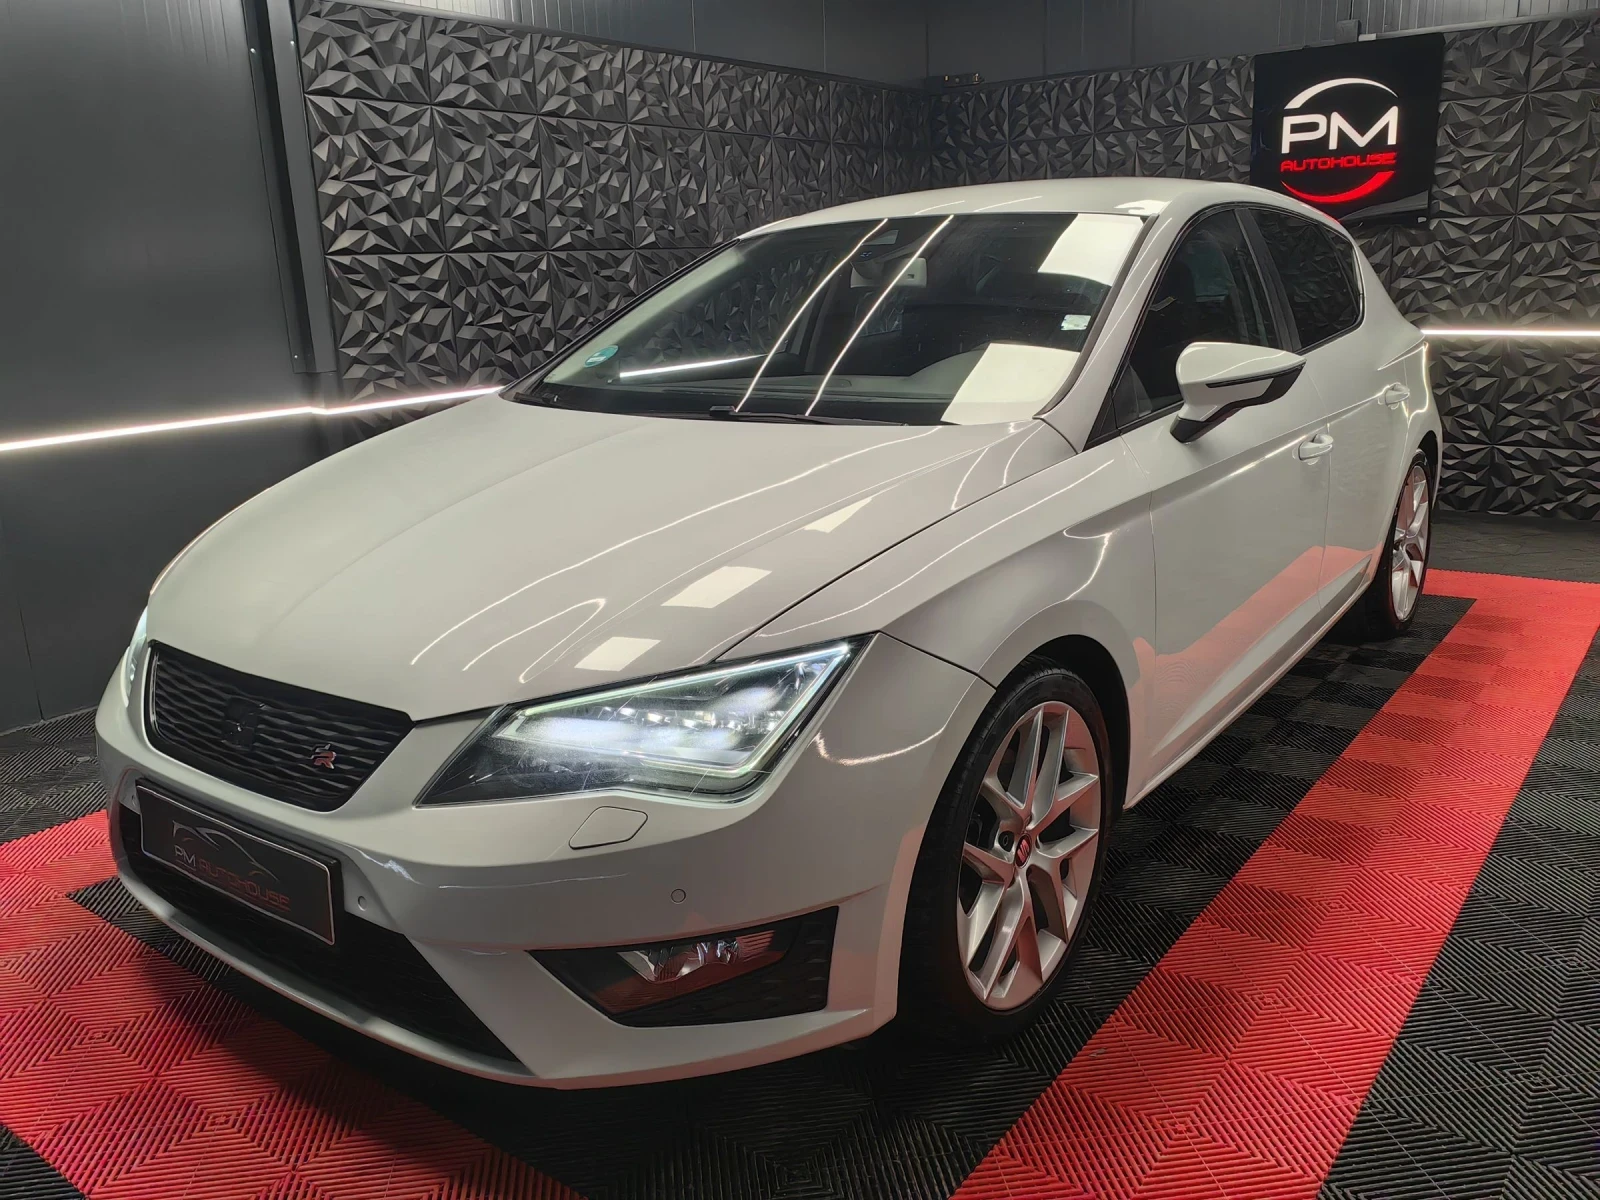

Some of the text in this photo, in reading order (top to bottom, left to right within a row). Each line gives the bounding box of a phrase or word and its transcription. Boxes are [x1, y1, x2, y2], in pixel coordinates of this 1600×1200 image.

[1281, 105, 1398, 154] PM
[1280, 152, 1397, 172] AUTOHOUSE
[173, 845, 290, 907] PM AUTOHOUSE
